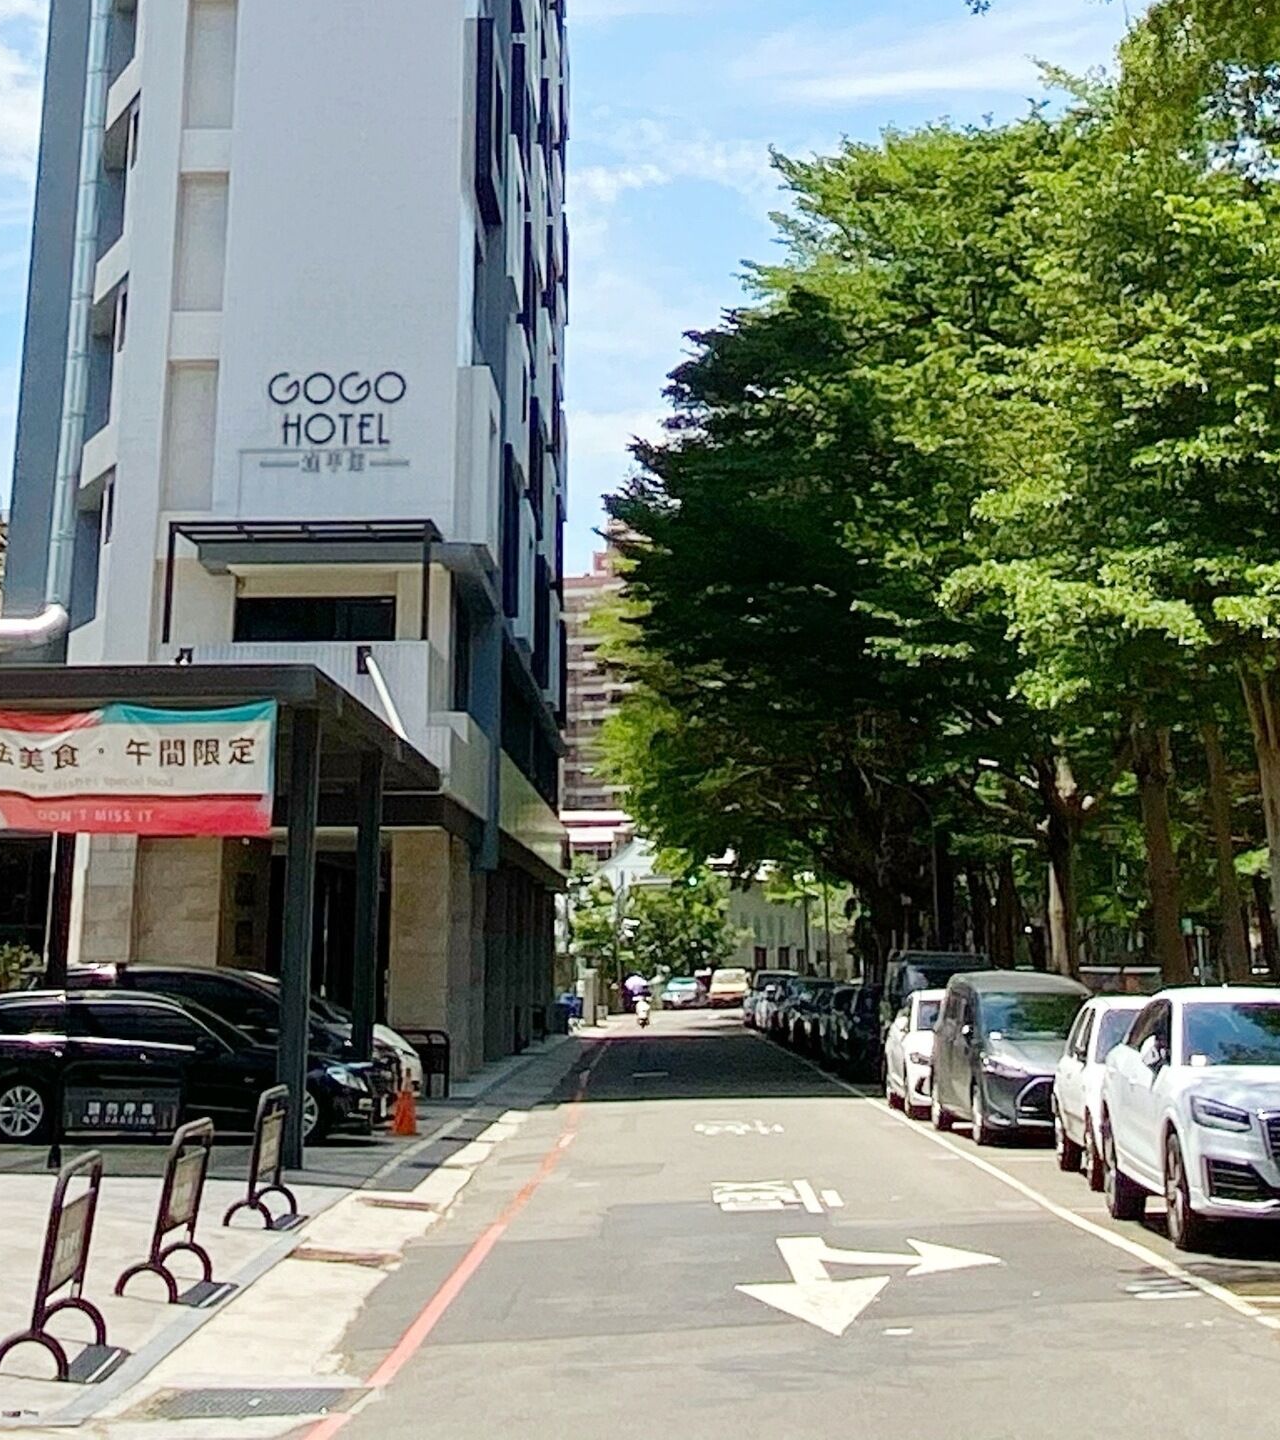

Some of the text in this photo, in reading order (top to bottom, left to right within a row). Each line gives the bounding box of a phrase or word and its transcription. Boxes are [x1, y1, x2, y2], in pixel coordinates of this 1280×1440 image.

[268, 371, 407, 405] GOGO
[282, 413, 391, 445] HOTEL
[125, 738, 256, 767] 午間限定
[94, 809, 133, 822] MISS
[138, 809, 153, 822] IT
